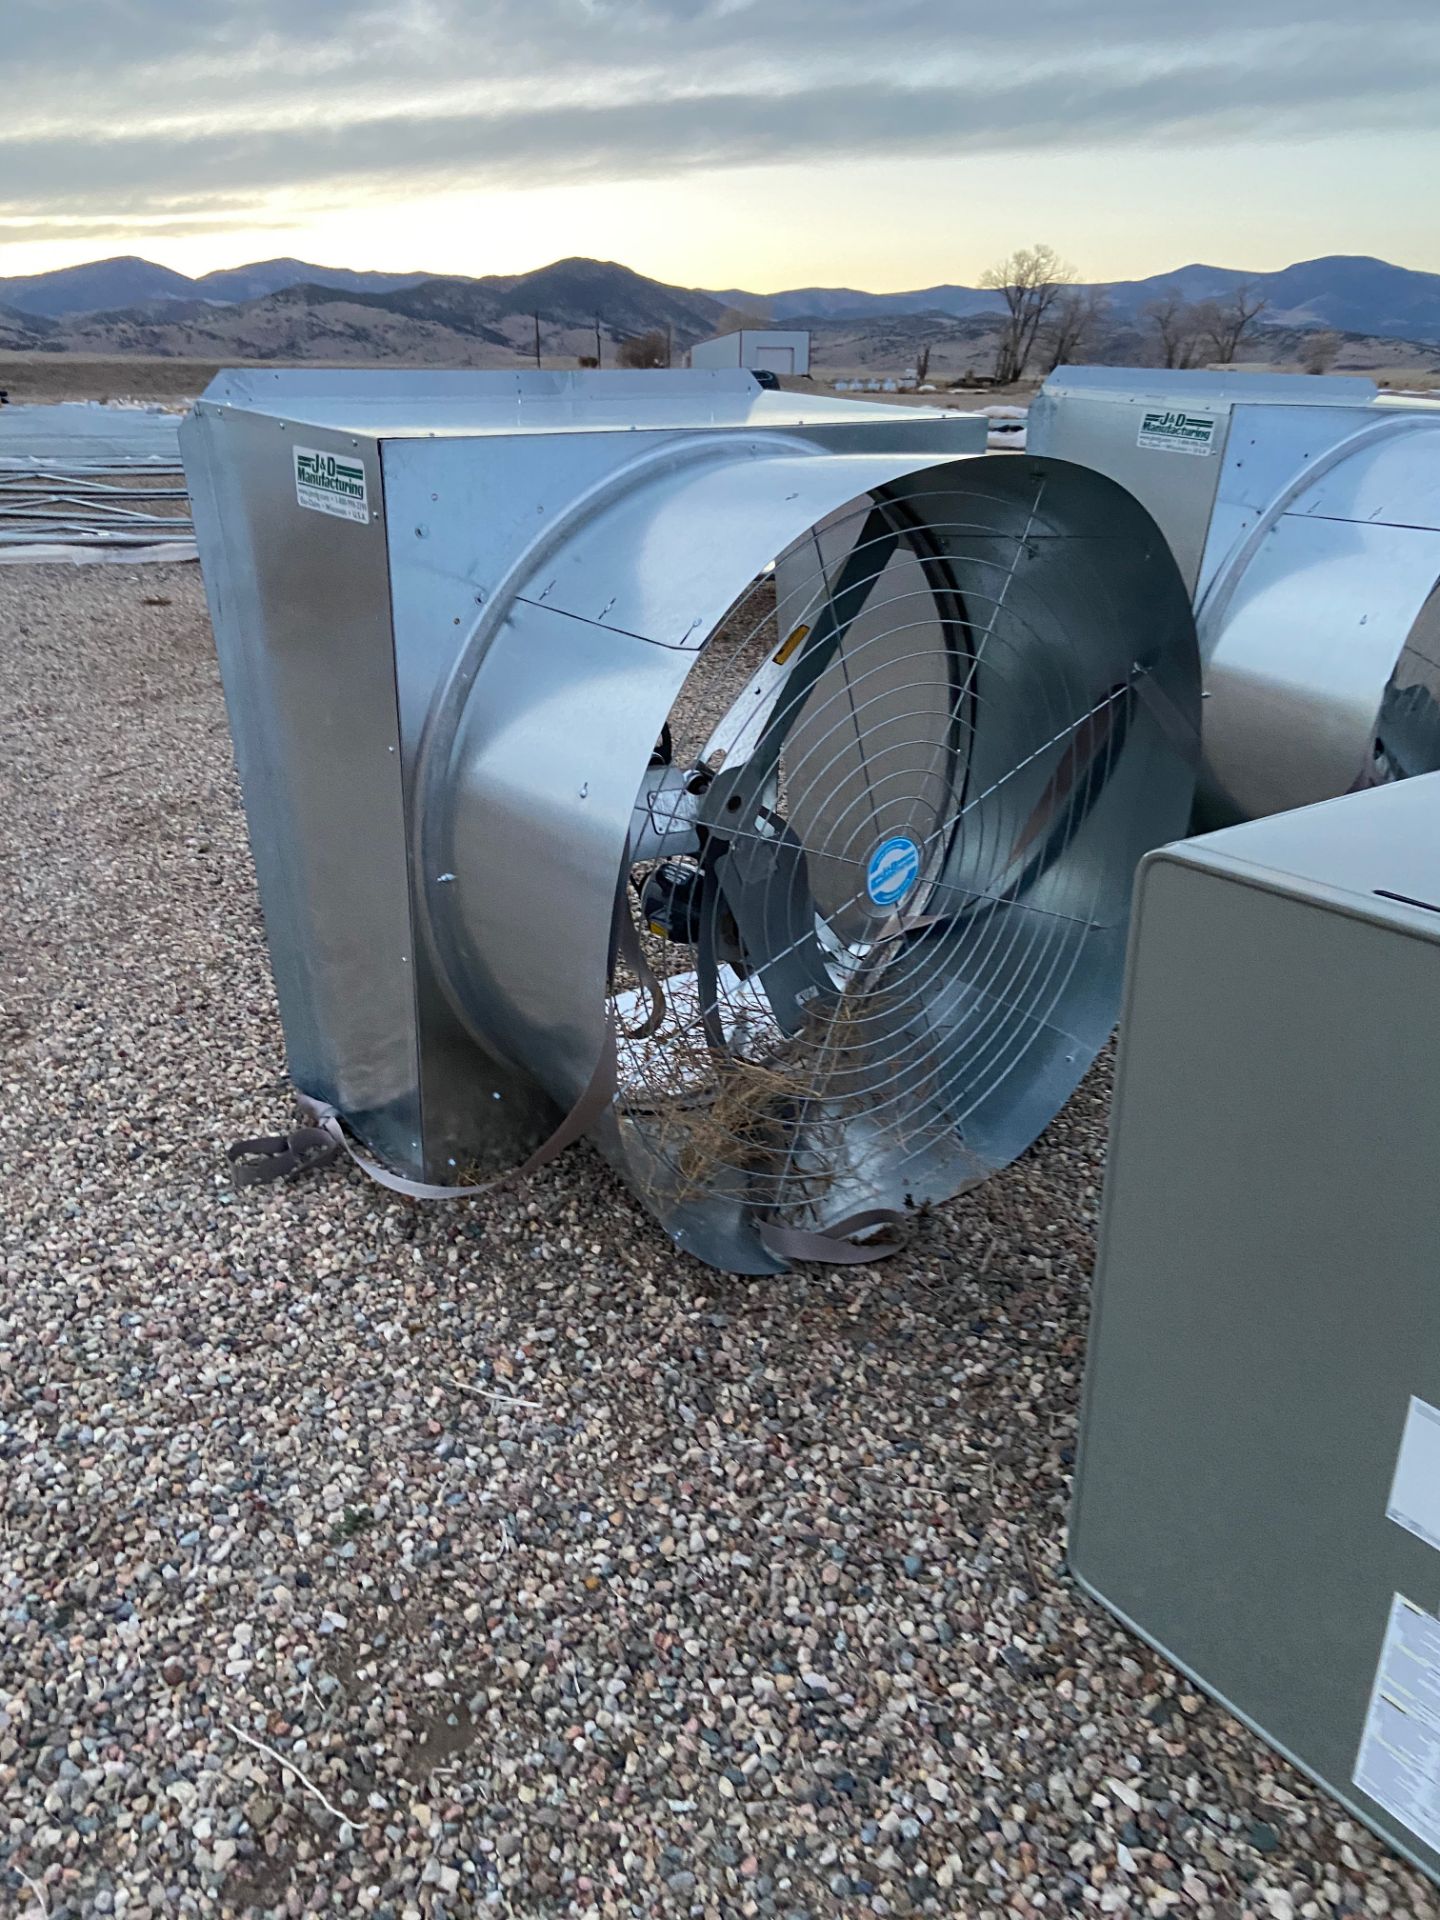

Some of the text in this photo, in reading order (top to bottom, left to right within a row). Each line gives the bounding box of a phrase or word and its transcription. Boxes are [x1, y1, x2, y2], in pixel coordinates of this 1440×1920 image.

[1160, 412, 1186, 427] J&D
[1142, 421, 1211, 441] Manufacturing
[312, 454, 336, 477] J&D
[298, 466, 364, 500] Manufacturing
